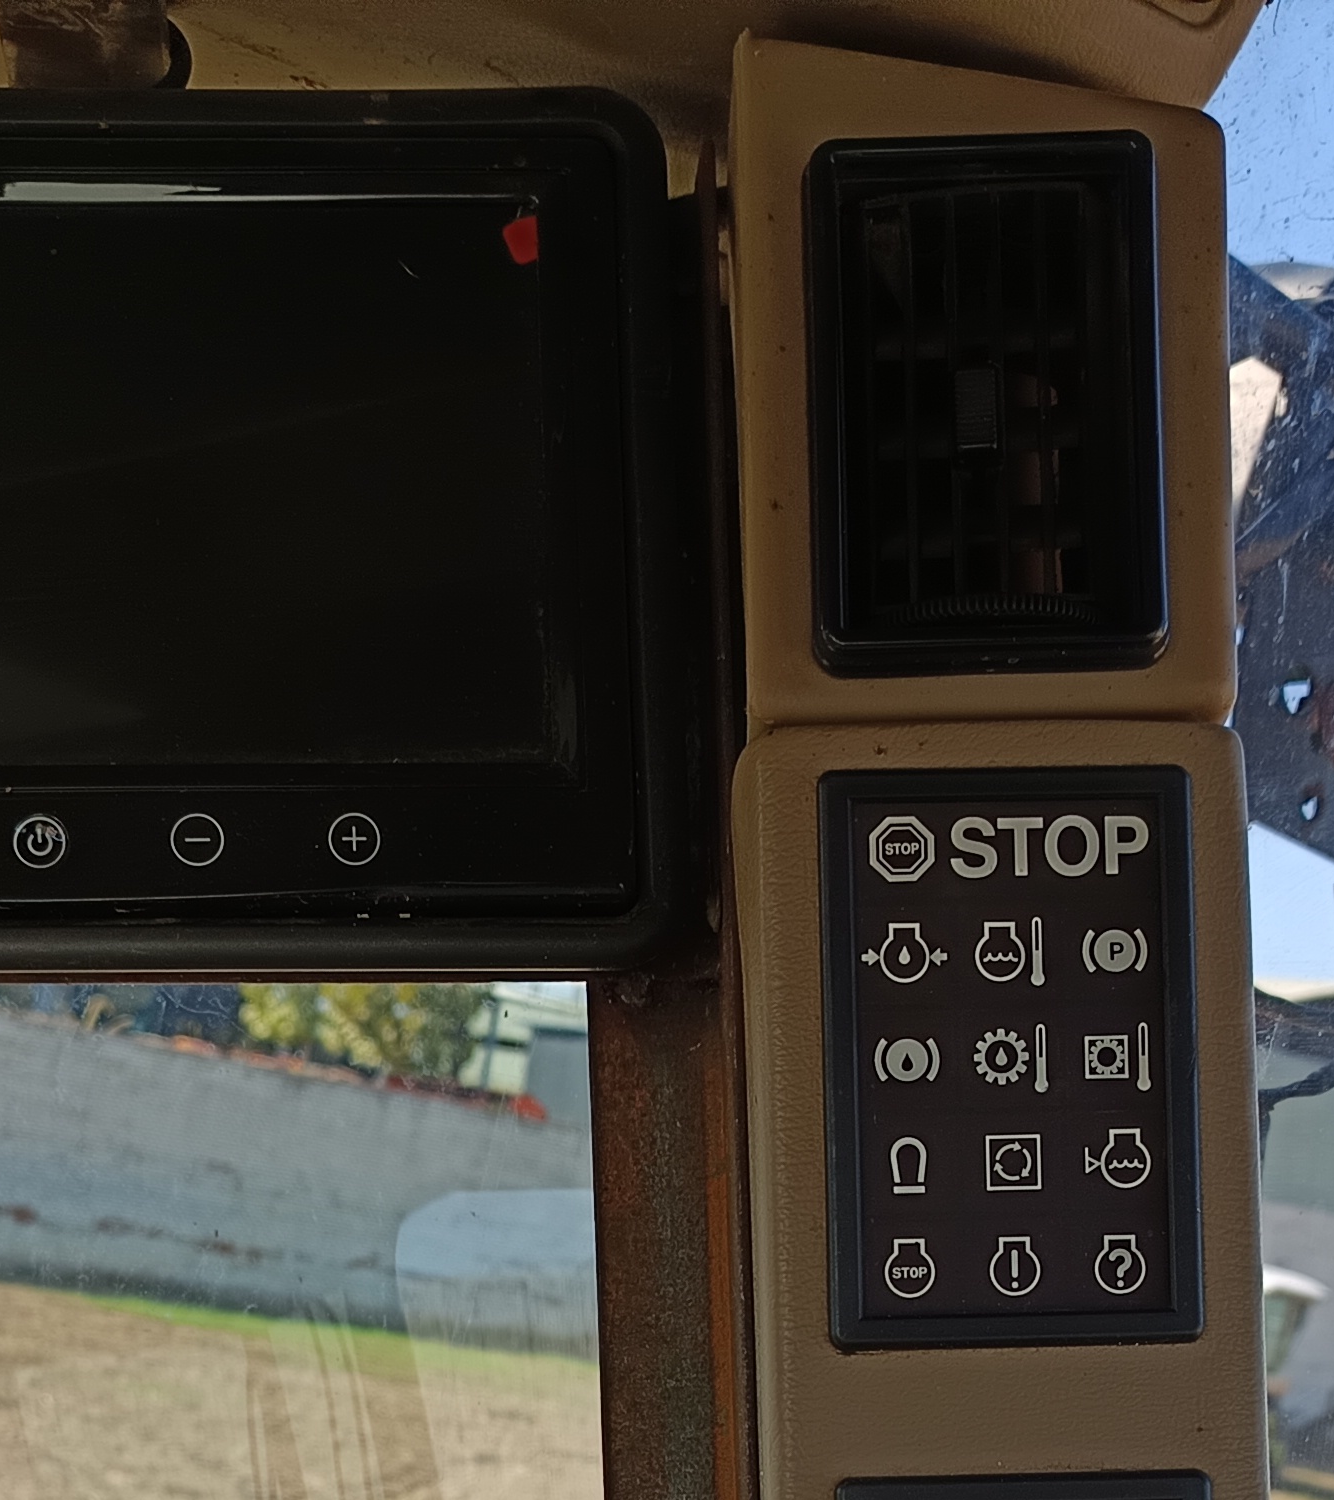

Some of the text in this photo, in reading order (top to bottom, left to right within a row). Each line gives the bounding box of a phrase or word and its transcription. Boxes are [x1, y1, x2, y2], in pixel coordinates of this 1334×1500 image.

[884, 842, 920, 856] STOP
[949, 814, 1150, 879] STOP
[1109, 941, 1124, 961] P
[891, 1266, 928, 1279] STOP
